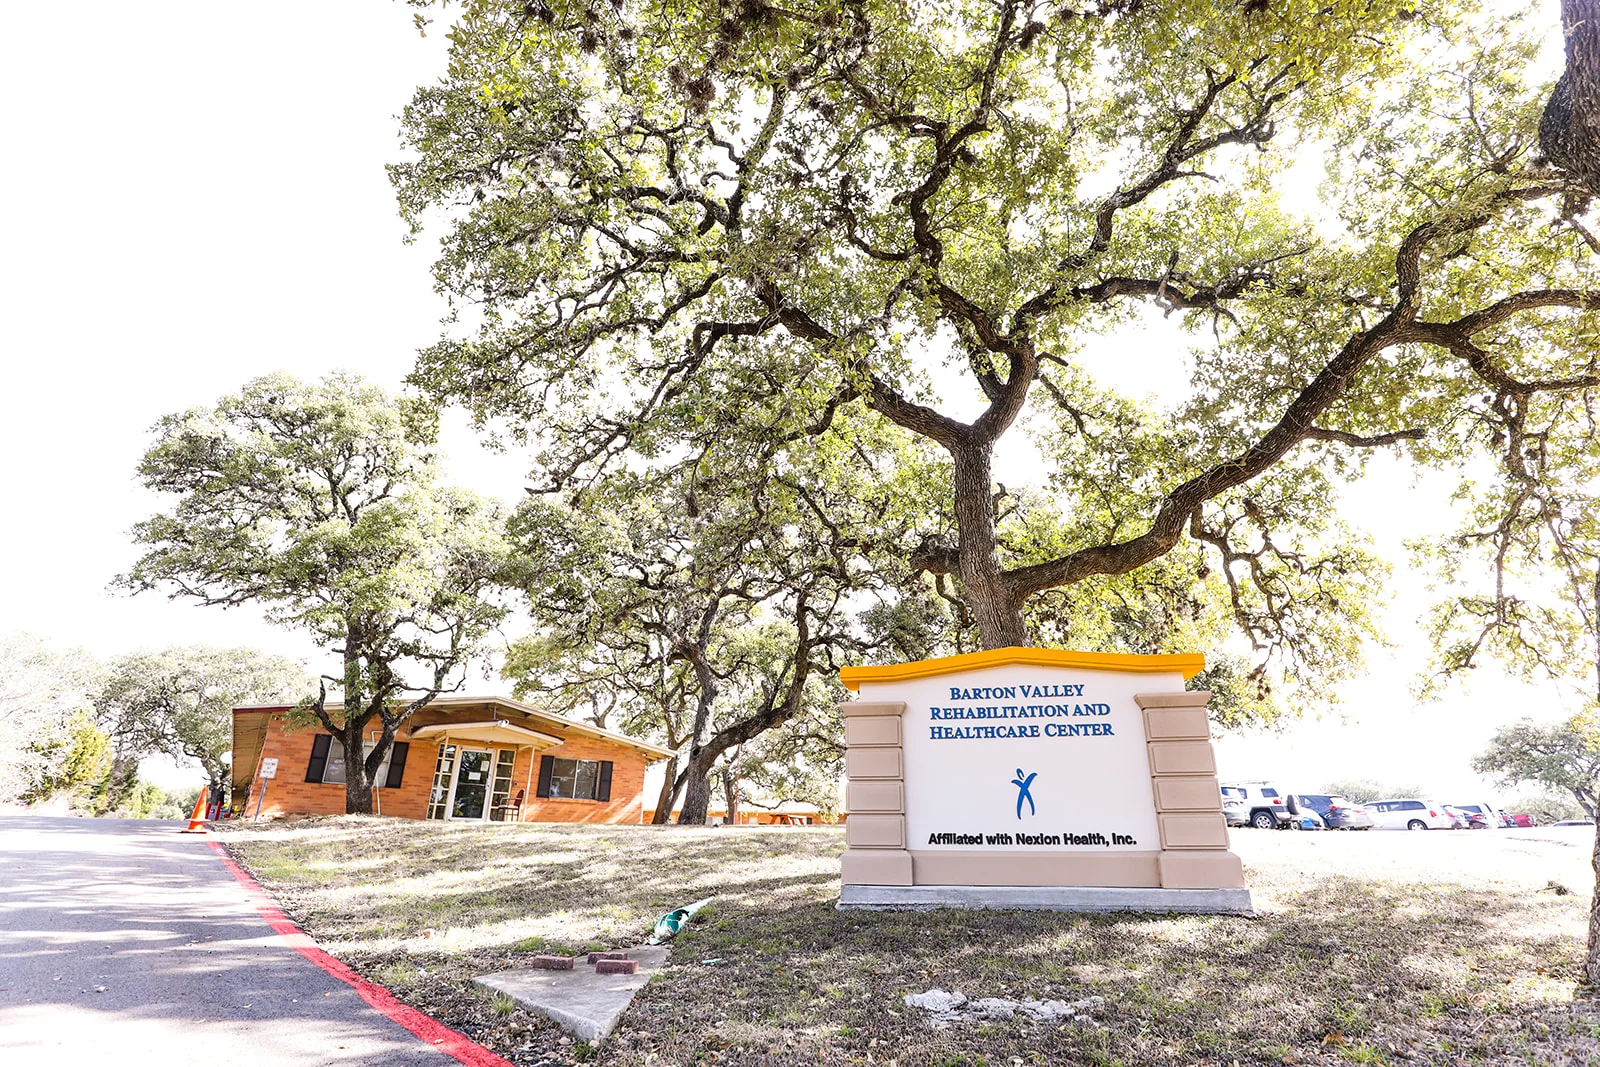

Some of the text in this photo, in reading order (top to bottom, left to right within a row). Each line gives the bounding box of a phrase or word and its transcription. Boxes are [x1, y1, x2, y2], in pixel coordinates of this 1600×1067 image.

[950, 684, 1084, 701] BARTON VALLEY
[929, 703, 1111, 720] REHABILITATION AND
[929, 723, 1115, 739] HEALTHCARE CENTER
[928, 832, 1137, 847] Affiliated with Nexion Health, Inc.
